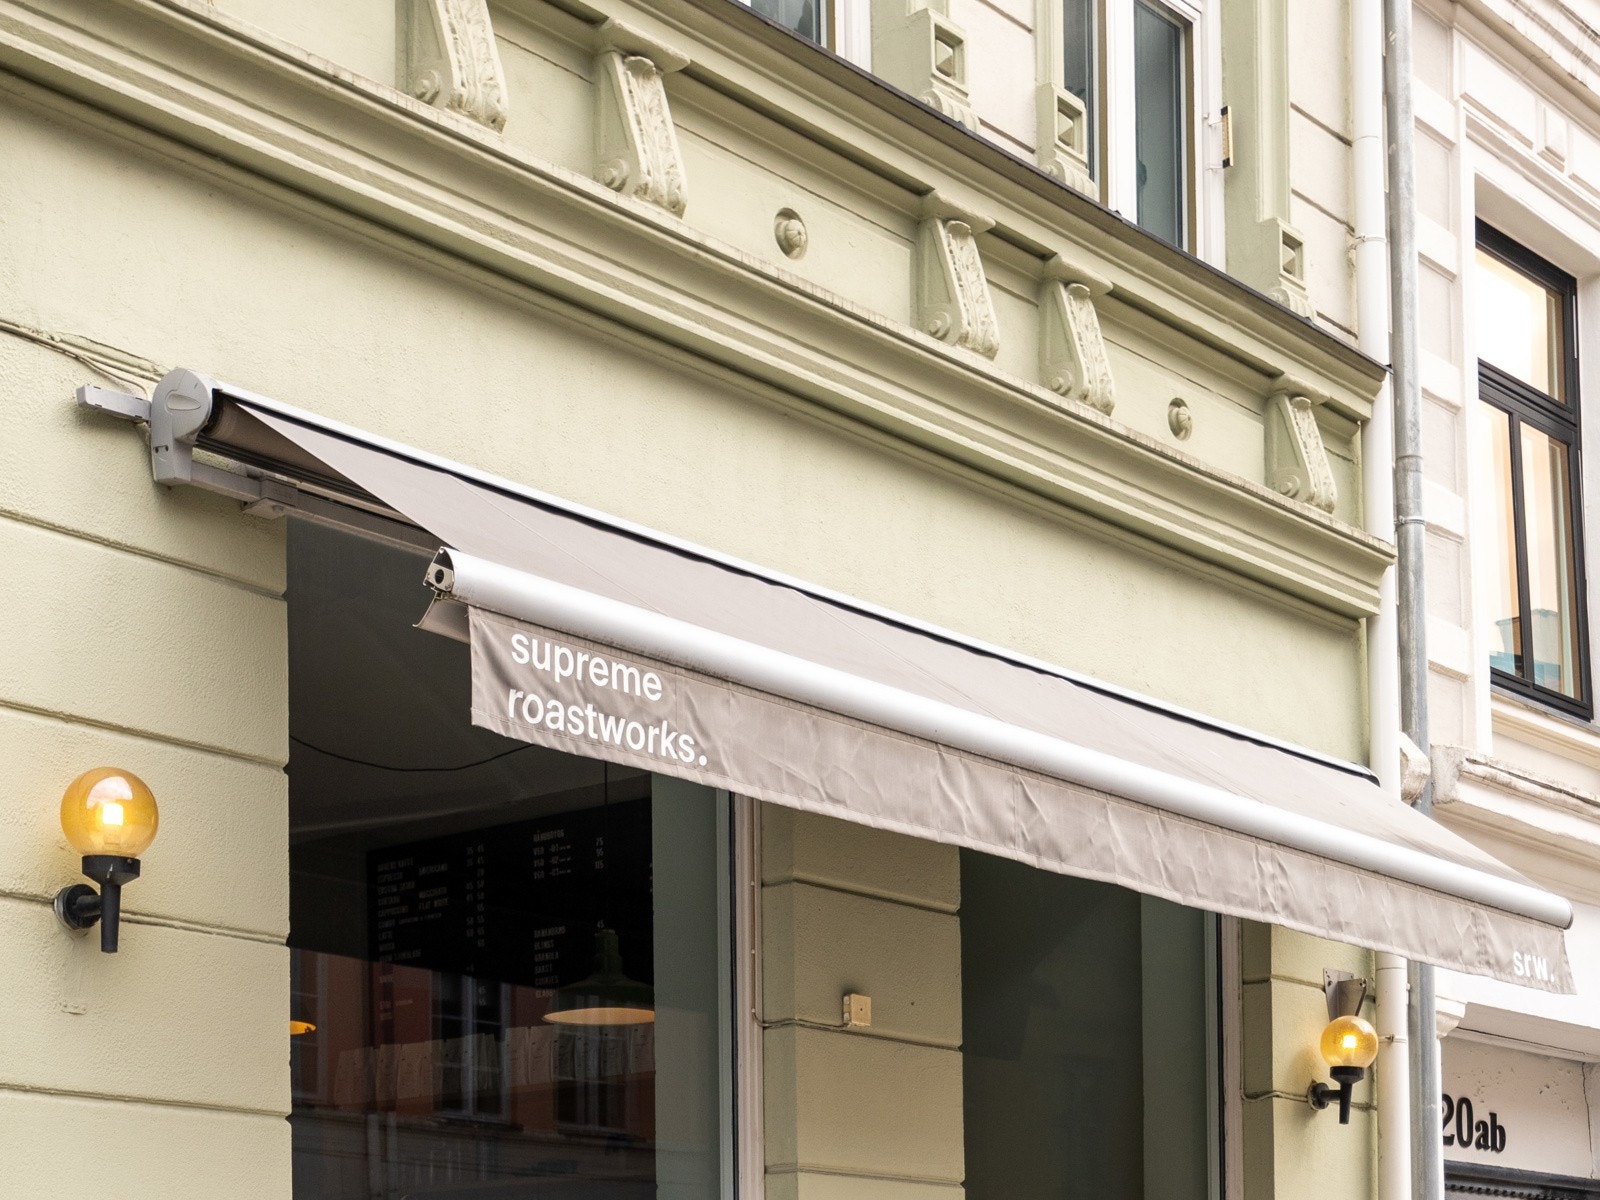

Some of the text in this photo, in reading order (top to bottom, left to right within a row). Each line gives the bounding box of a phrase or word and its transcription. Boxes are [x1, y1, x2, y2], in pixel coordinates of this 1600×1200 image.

[511, 633, 663, 701] supreme
[508, 688, 708, 766] roastworks.
[1512, 951, 1555, 983] srw.
[1442, 1093, 1506, 1154] 20ab
